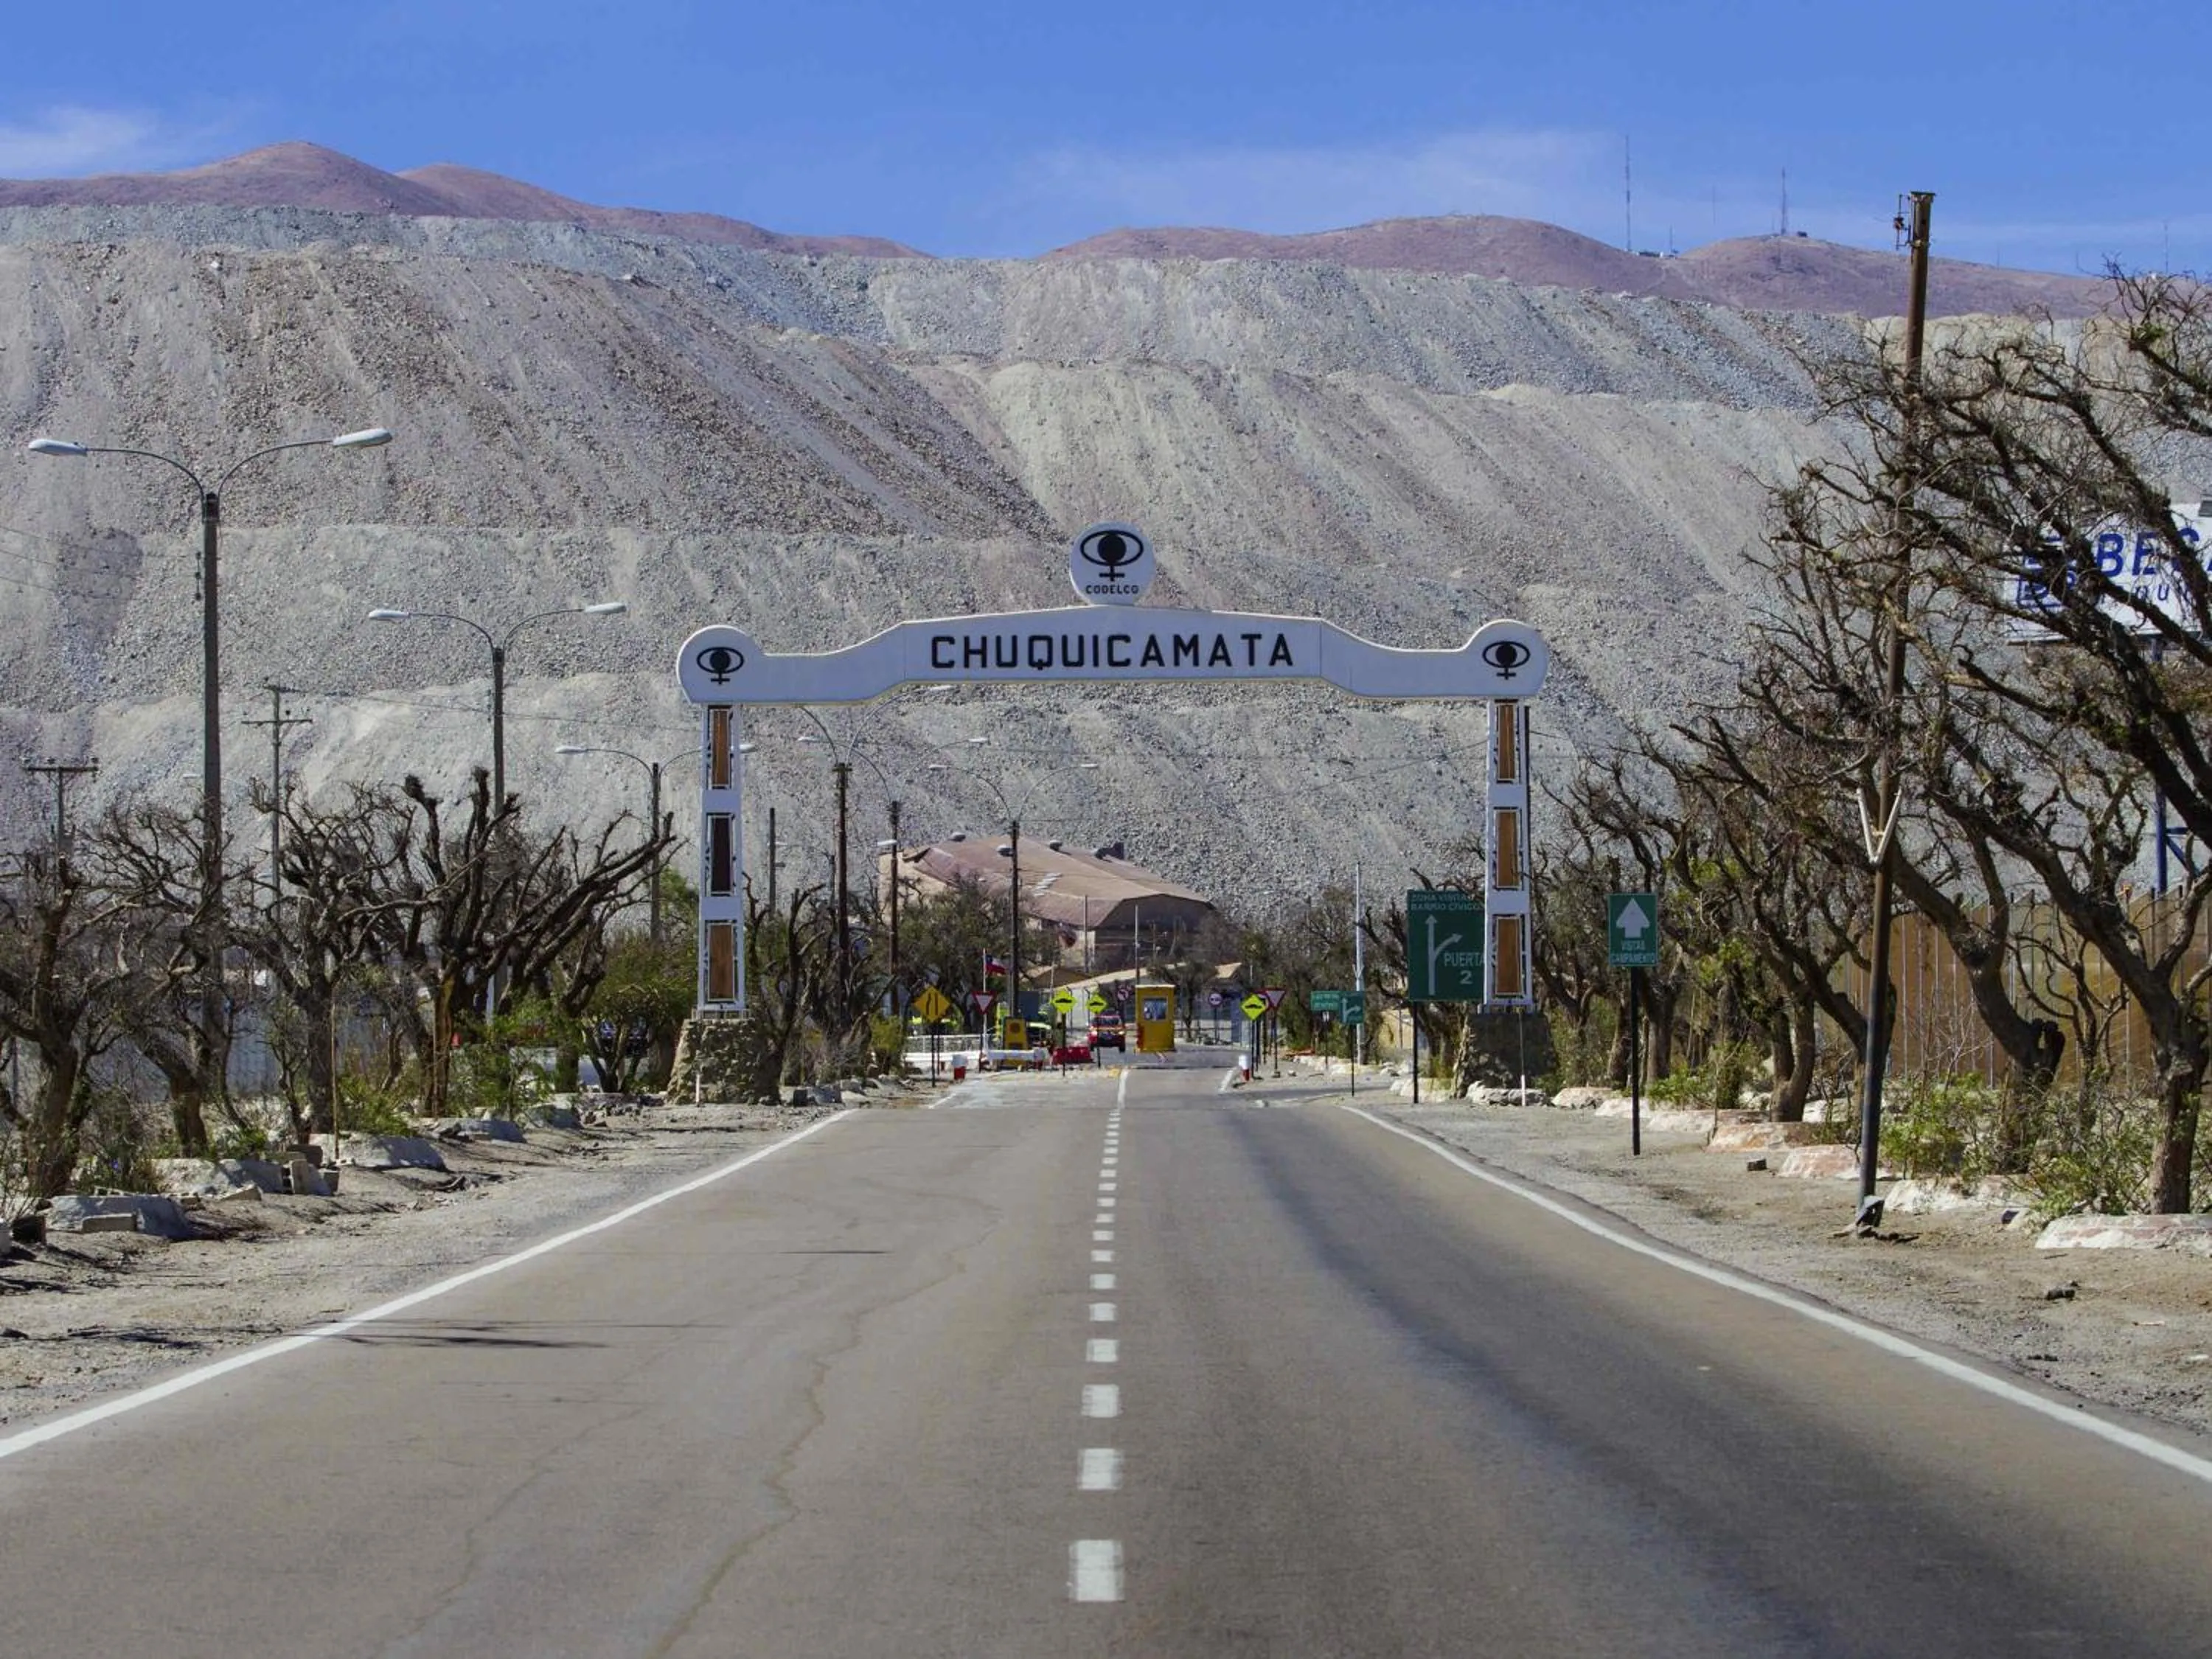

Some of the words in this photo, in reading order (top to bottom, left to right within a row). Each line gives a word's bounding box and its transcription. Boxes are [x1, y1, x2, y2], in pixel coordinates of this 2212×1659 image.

[1085, 584, 1139, 594] CODELCO
[931, 633, 1293, 670] CHUQUICAMATA
[1460, 970, 1473, 984] 2
